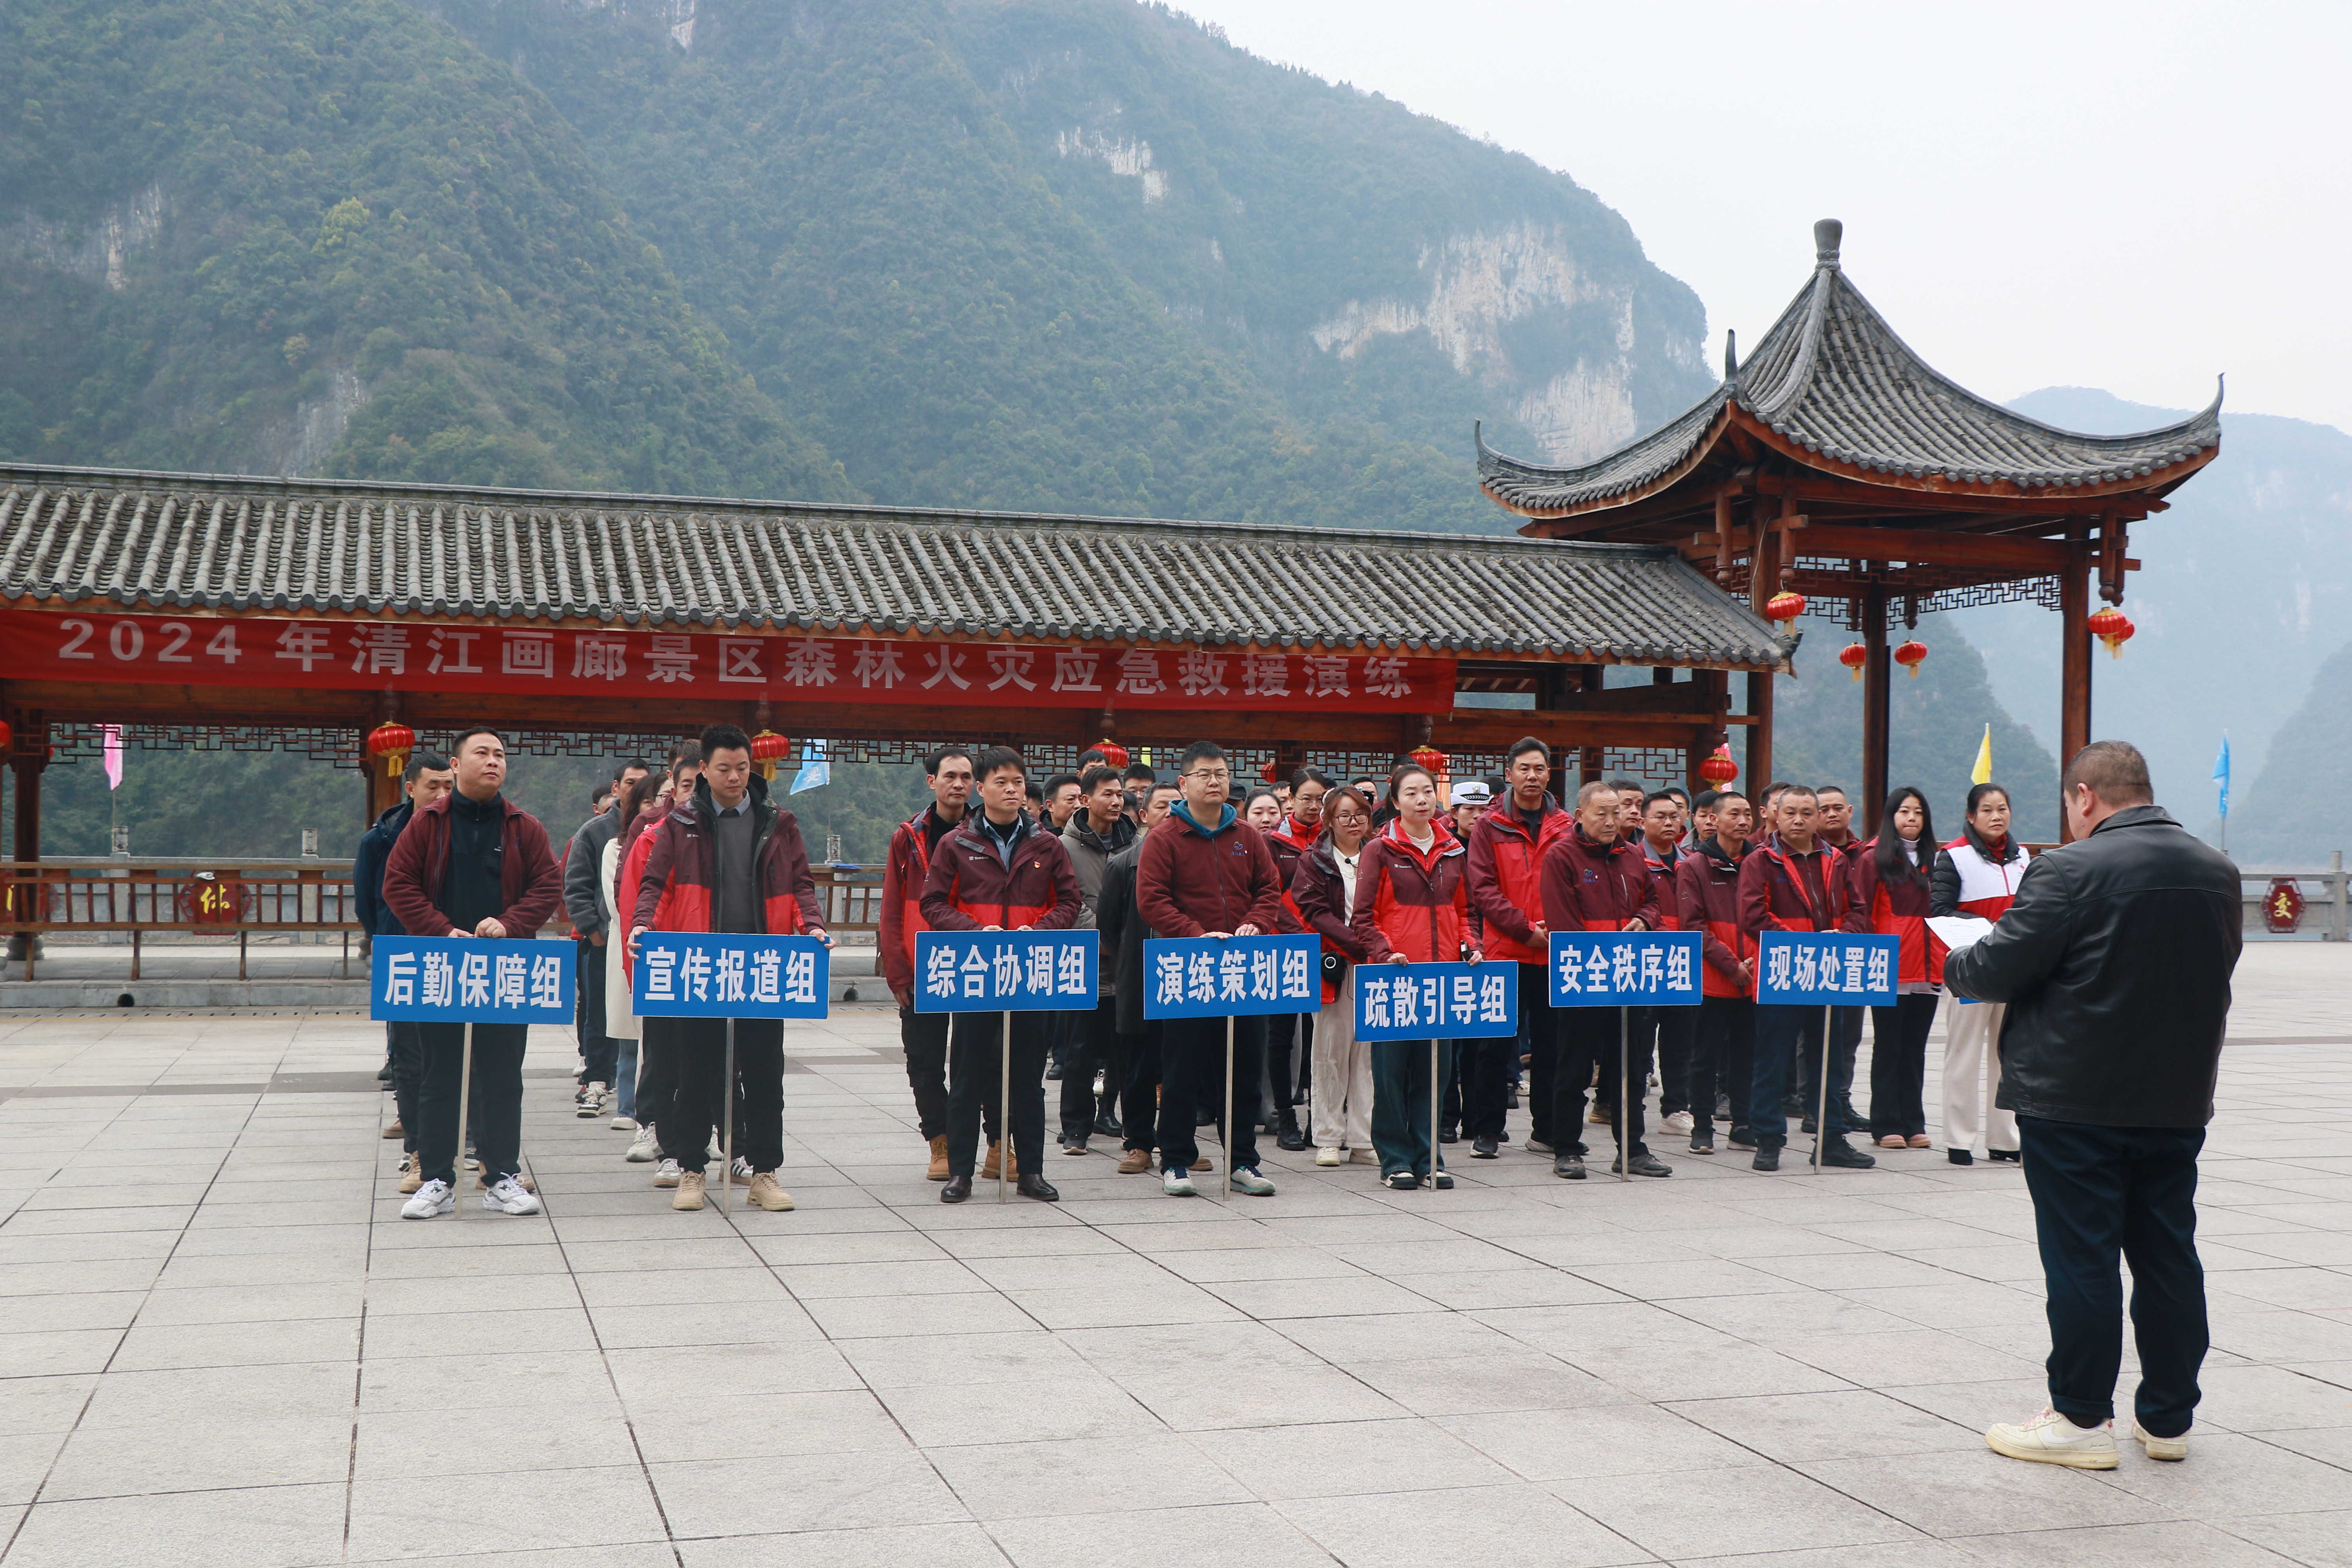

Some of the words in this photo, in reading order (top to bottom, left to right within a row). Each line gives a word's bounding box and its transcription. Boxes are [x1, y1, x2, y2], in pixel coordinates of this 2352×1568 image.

[384, 951, 562, 1009] 后勤保障组
[645, 946, 817, 1003] 宣传报道组
[927, 944, 1087, 998] 综合协调组
[1156, 948, 1310, 1005] 演练策划组
[1559, 944, 1692, 994] 安全秩序组
[1767, 946, 1889, 992] 现场处置组
[1364, 975, 1507, 1028] 疏散引导组
